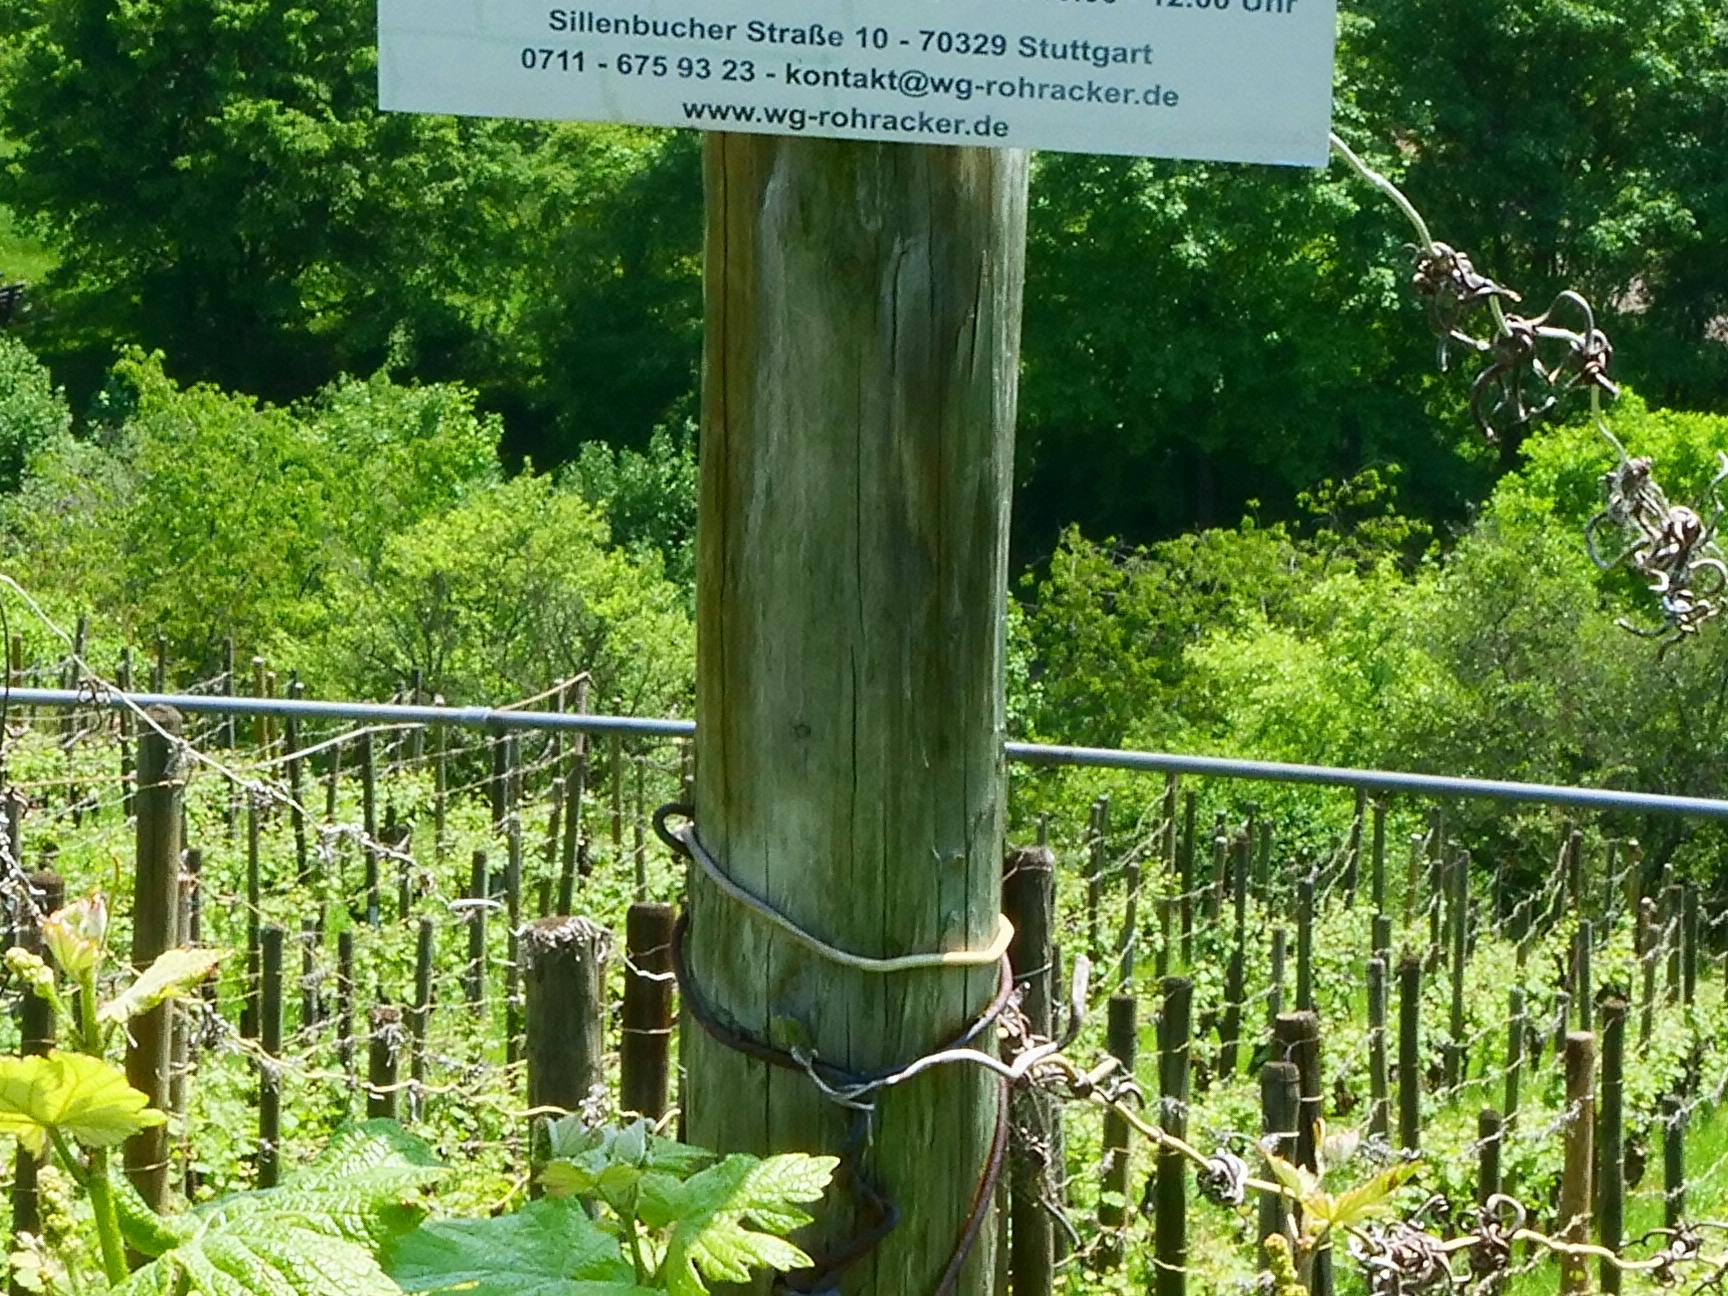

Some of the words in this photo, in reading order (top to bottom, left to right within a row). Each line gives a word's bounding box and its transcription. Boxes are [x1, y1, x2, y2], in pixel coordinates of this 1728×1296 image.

[548, 9, 738, 41] Sillenbucher
[746, 20, 845, 48] Straße
[855, 26, 889, 50] 10
[918, 29, 1008, 57] 70329
[1017, 35, 1154, 67] Stuttgart
[521, 47, 584, 73] 0711
[616, 52, 668, 78] 675
[676, 56, 712, 81] 93
[721, 58, 756, 83] 23
[785, 62, 1179, 108] kontakt@wg-rohracker.de
[682, 101, 1010, 138] www.wg-rohracker.de
